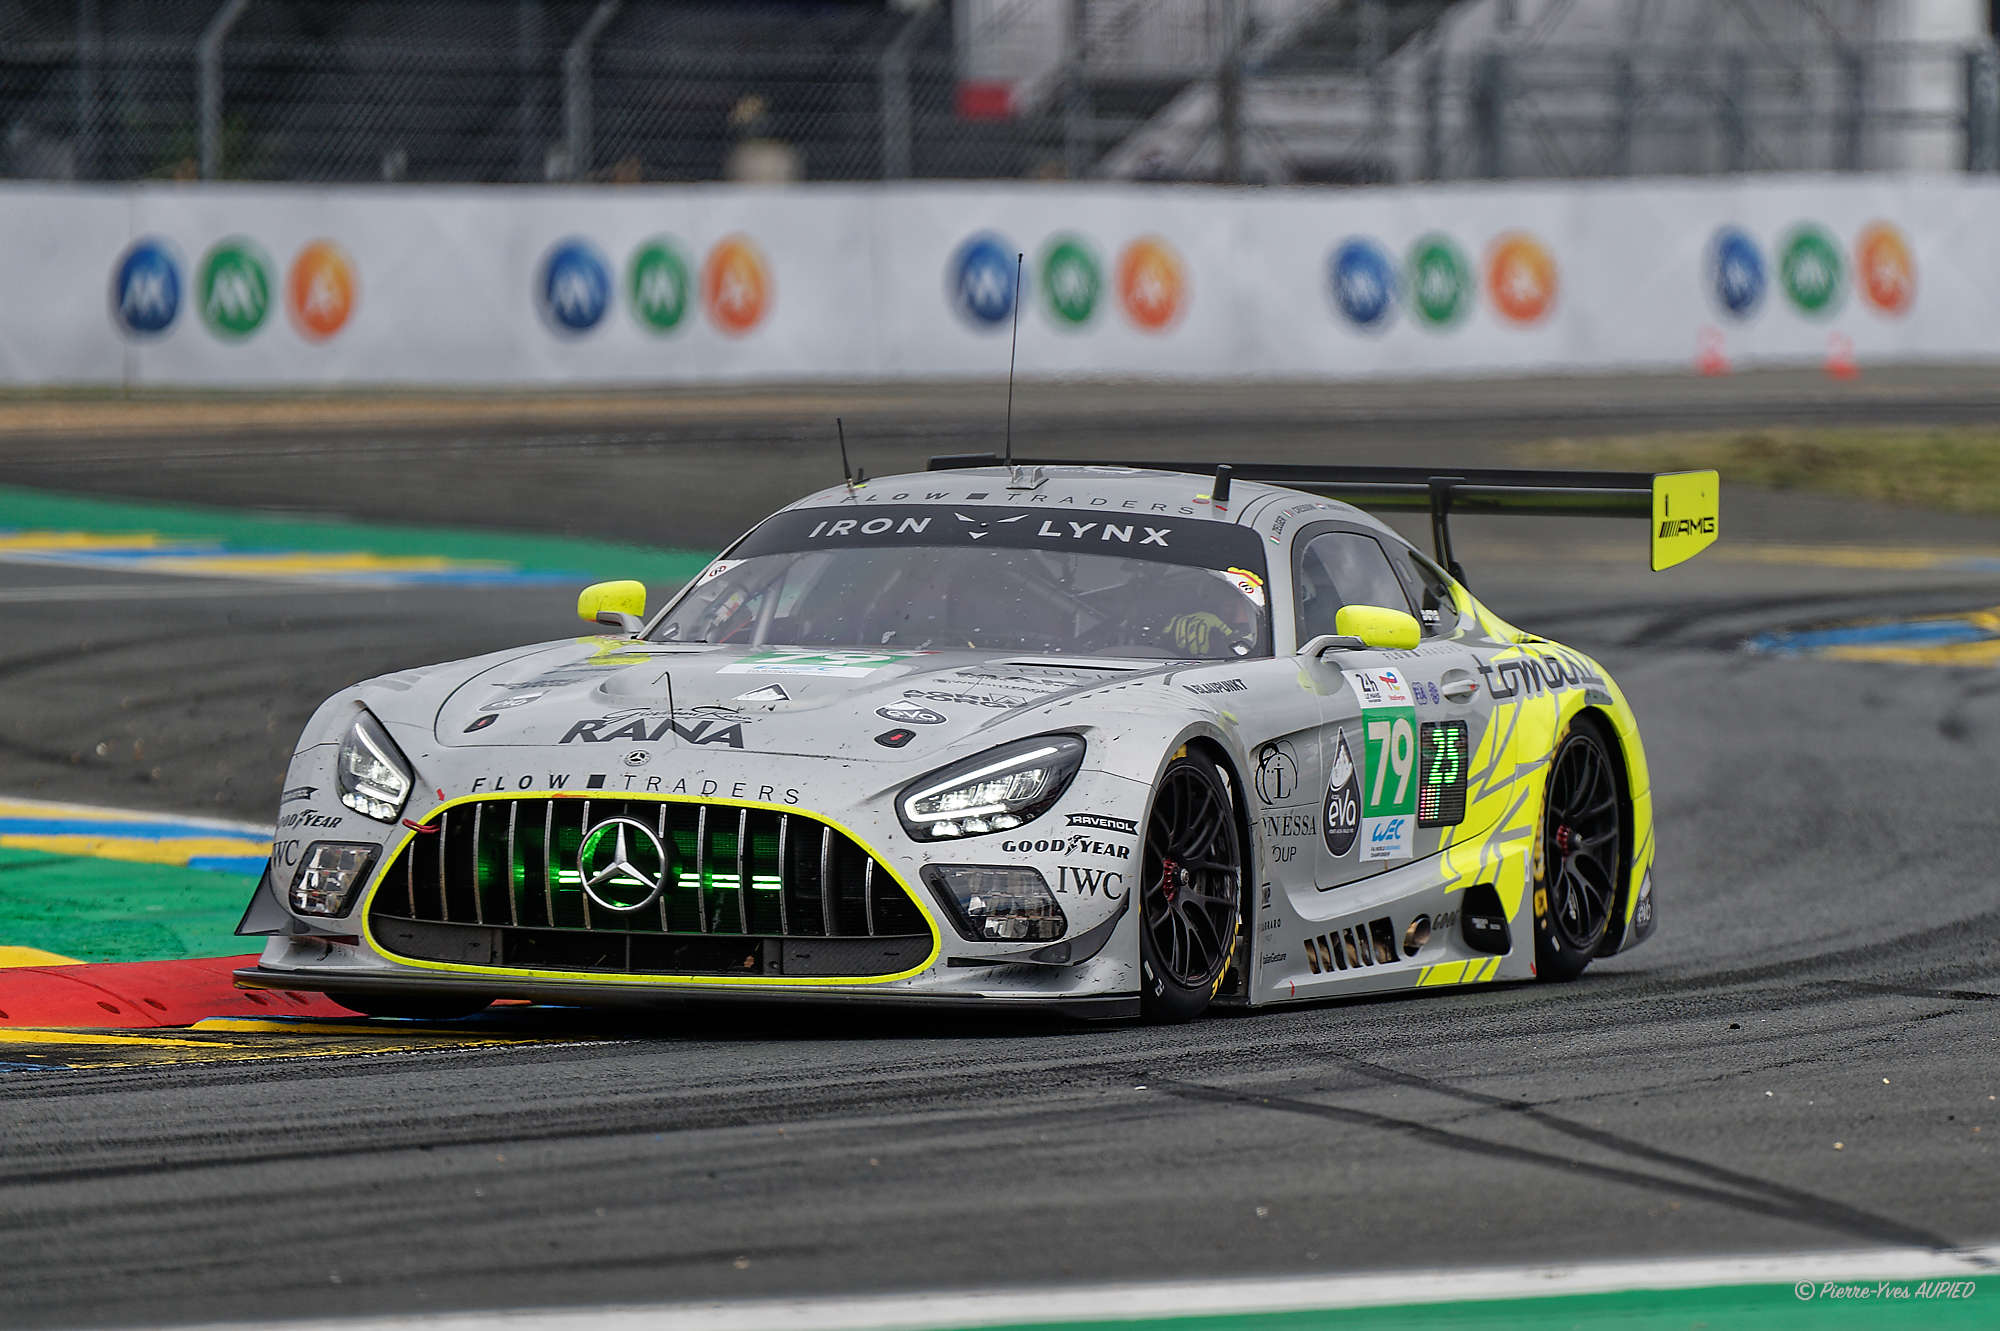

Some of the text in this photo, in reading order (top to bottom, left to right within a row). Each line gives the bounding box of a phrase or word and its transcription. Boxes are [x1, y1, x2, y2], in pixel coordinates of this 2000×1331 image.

[841, 491, 1196, 515] FLOW TRADERS
[808, 517, 1171, 547] IRON LYNX
[558, 718, 745, 749] RANA
[1367, 718, 1415, 807] 79
[1428, 728, 1460, 784] 25
[471, 774, 801, 805] FLOW TRADERS
[1072, 815, 1134, 832] RAVENOL
[1371, 818, 1405, 842] WEC
[1002, 836, 1131, 860] GOODYEAR
[1056, 865, 1123, 900] IWC
